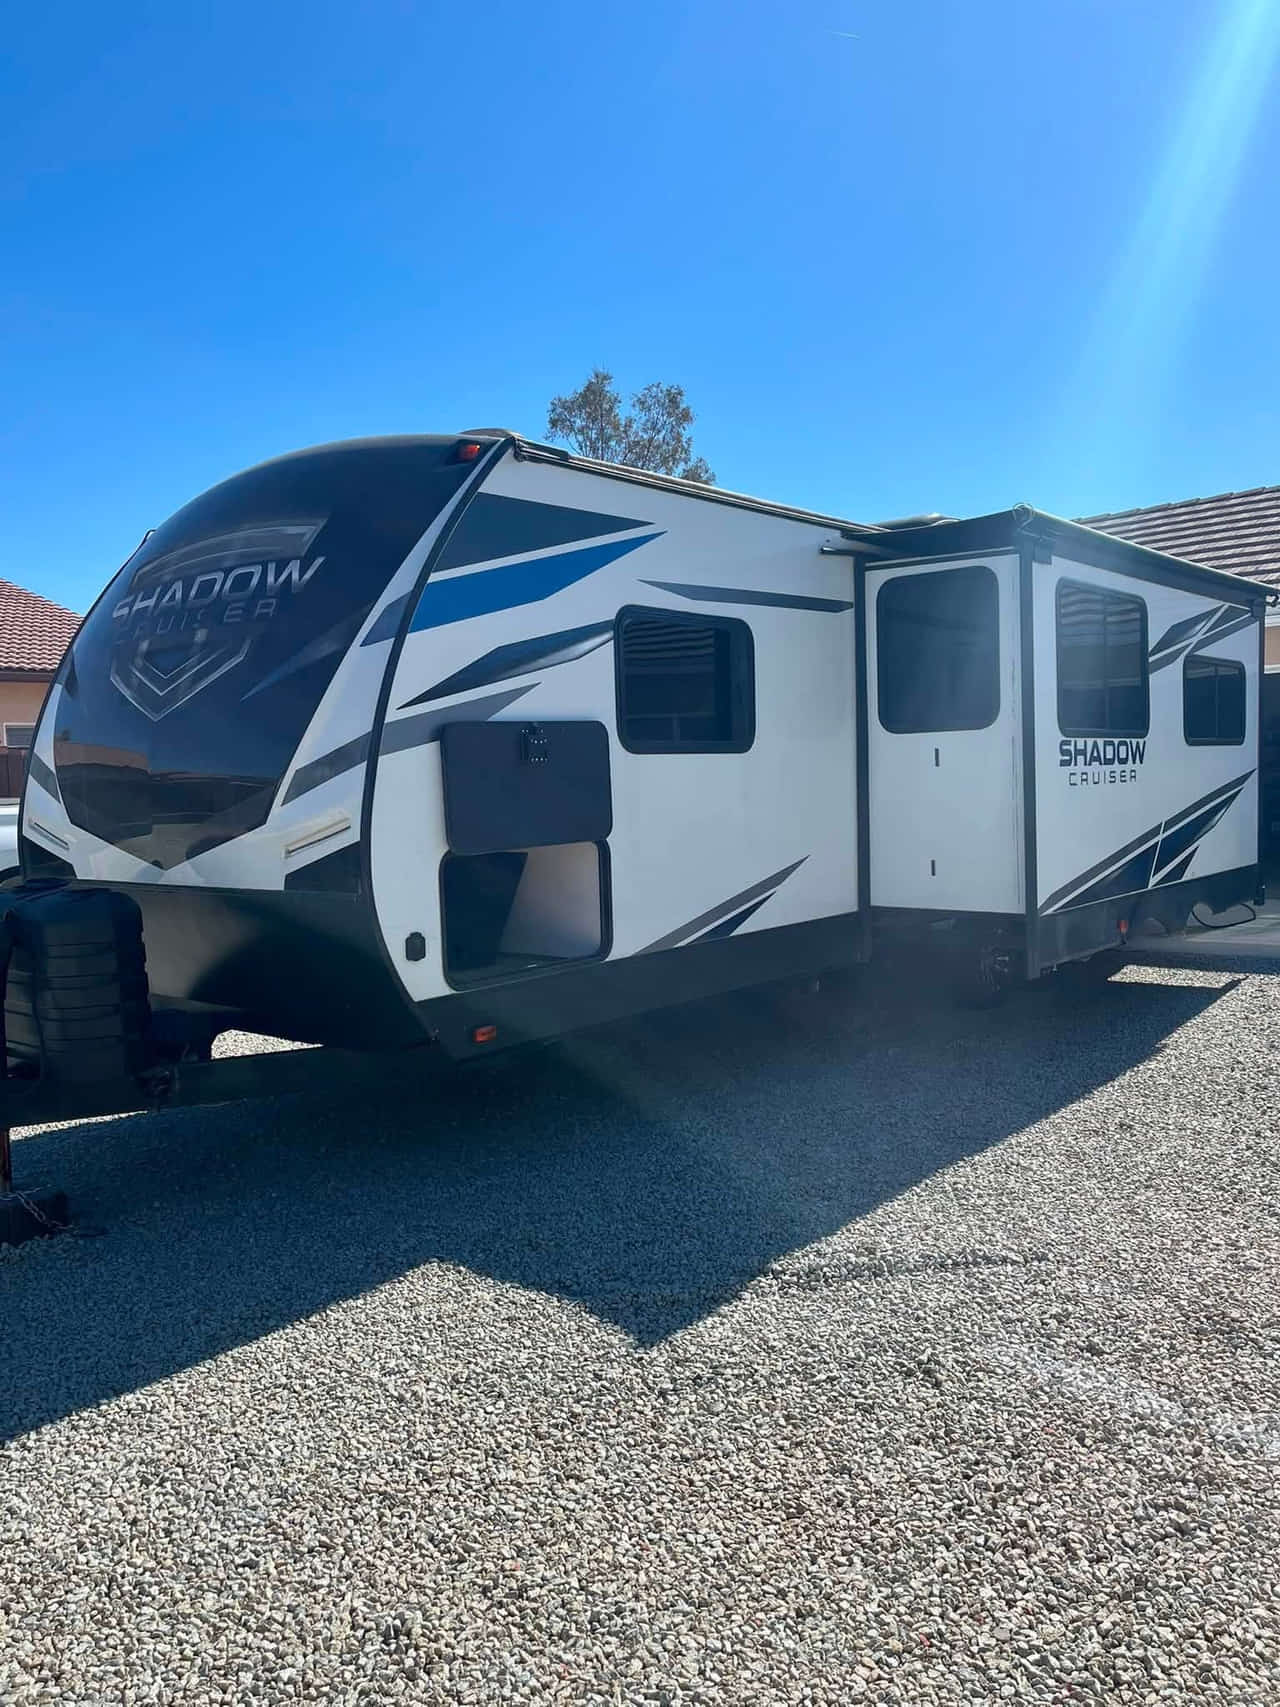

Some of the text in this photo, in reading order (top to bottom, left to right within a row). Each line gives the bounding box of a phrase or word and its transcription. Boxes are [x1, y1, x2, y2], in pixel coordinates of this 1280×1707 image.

[113, 556, 326, 618] SHADOW
[1059, 740, 1146, 767] SHADOW
[1069, 769, 1137, 786] CRUISER
